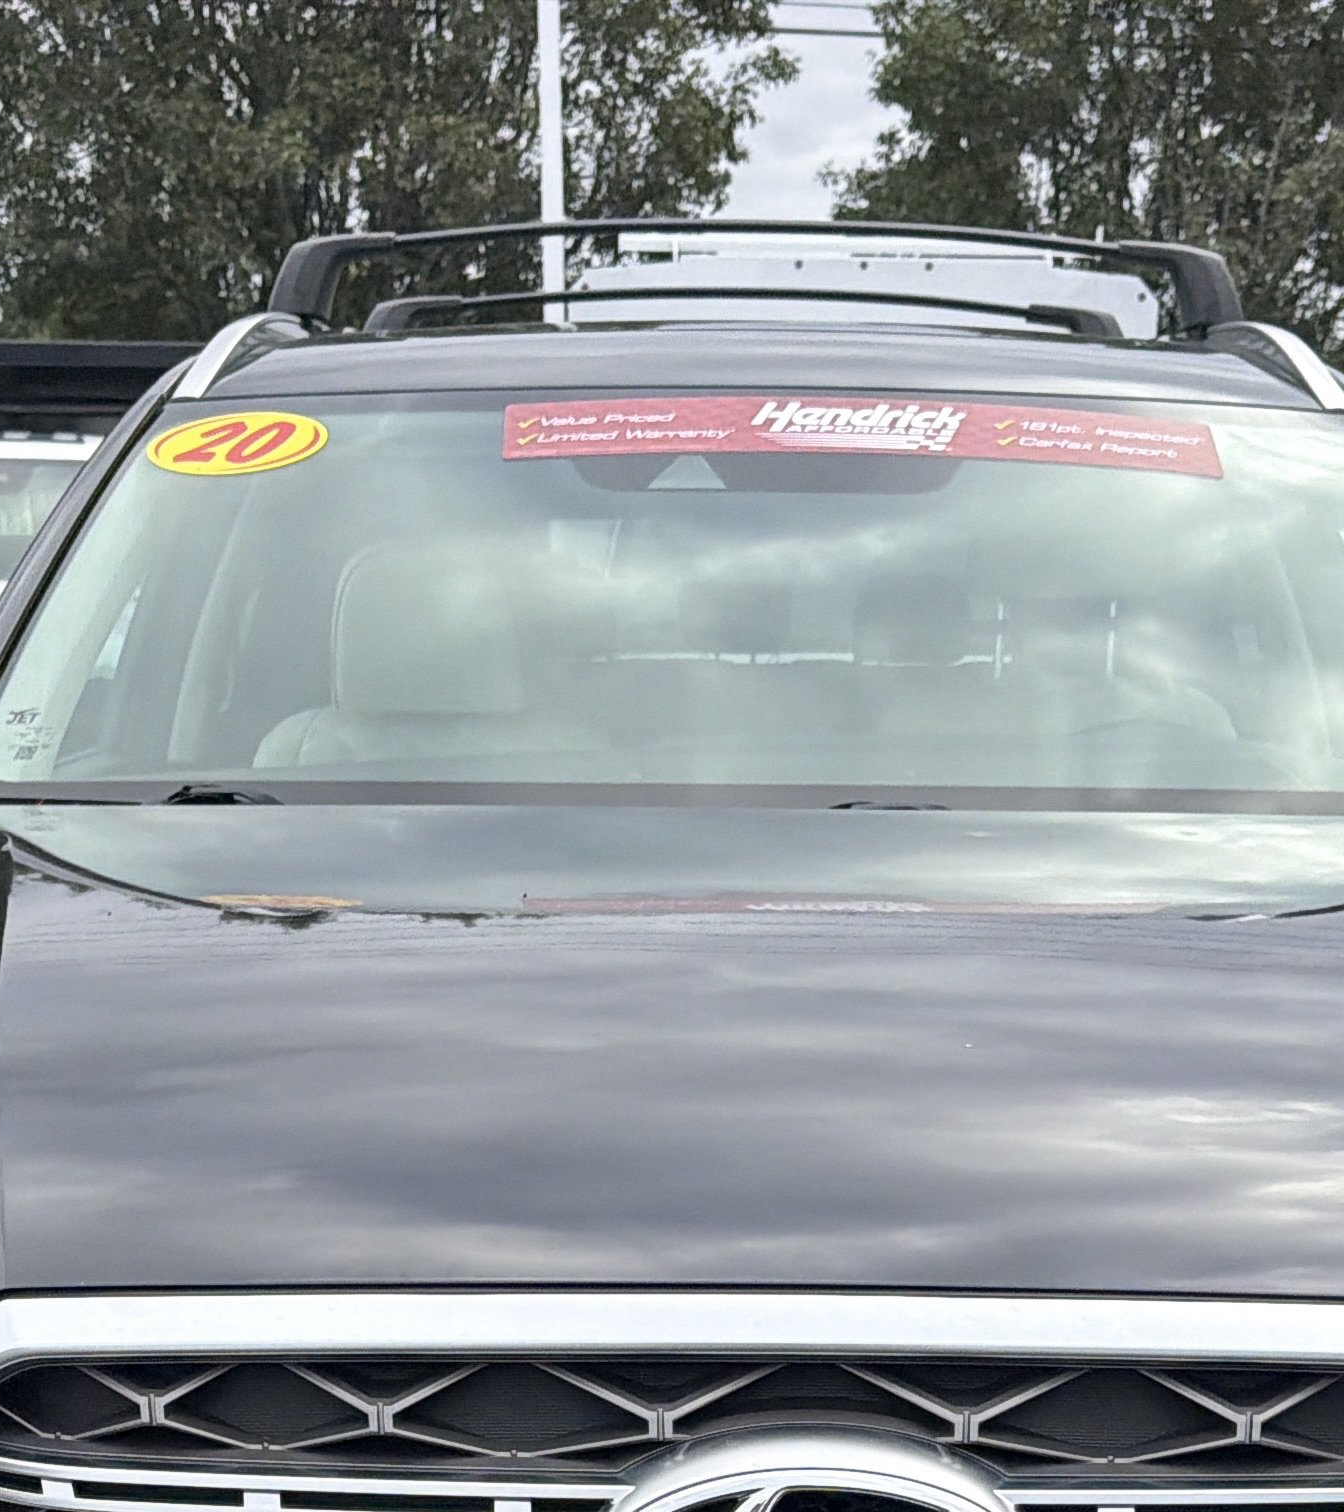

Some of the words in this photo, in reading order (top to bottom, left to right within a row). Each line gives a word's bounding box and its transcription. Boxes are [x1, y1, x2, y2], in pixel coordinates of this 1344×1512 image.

[540, 415, 598, 427] Value
[603, 410, 677, 424] Priced
[751, 400, 968, 433] Hendrick
[537, 430, 620, 444] Limited
[785, 424, 957, 437] AFFORDABLE
[1094, 426, 1203, 446] Inspected
[173, 421, 297, 464] 20
[1018, 436, 1093, 452] Carfax
[1100, 443, 1178, 459] Report
